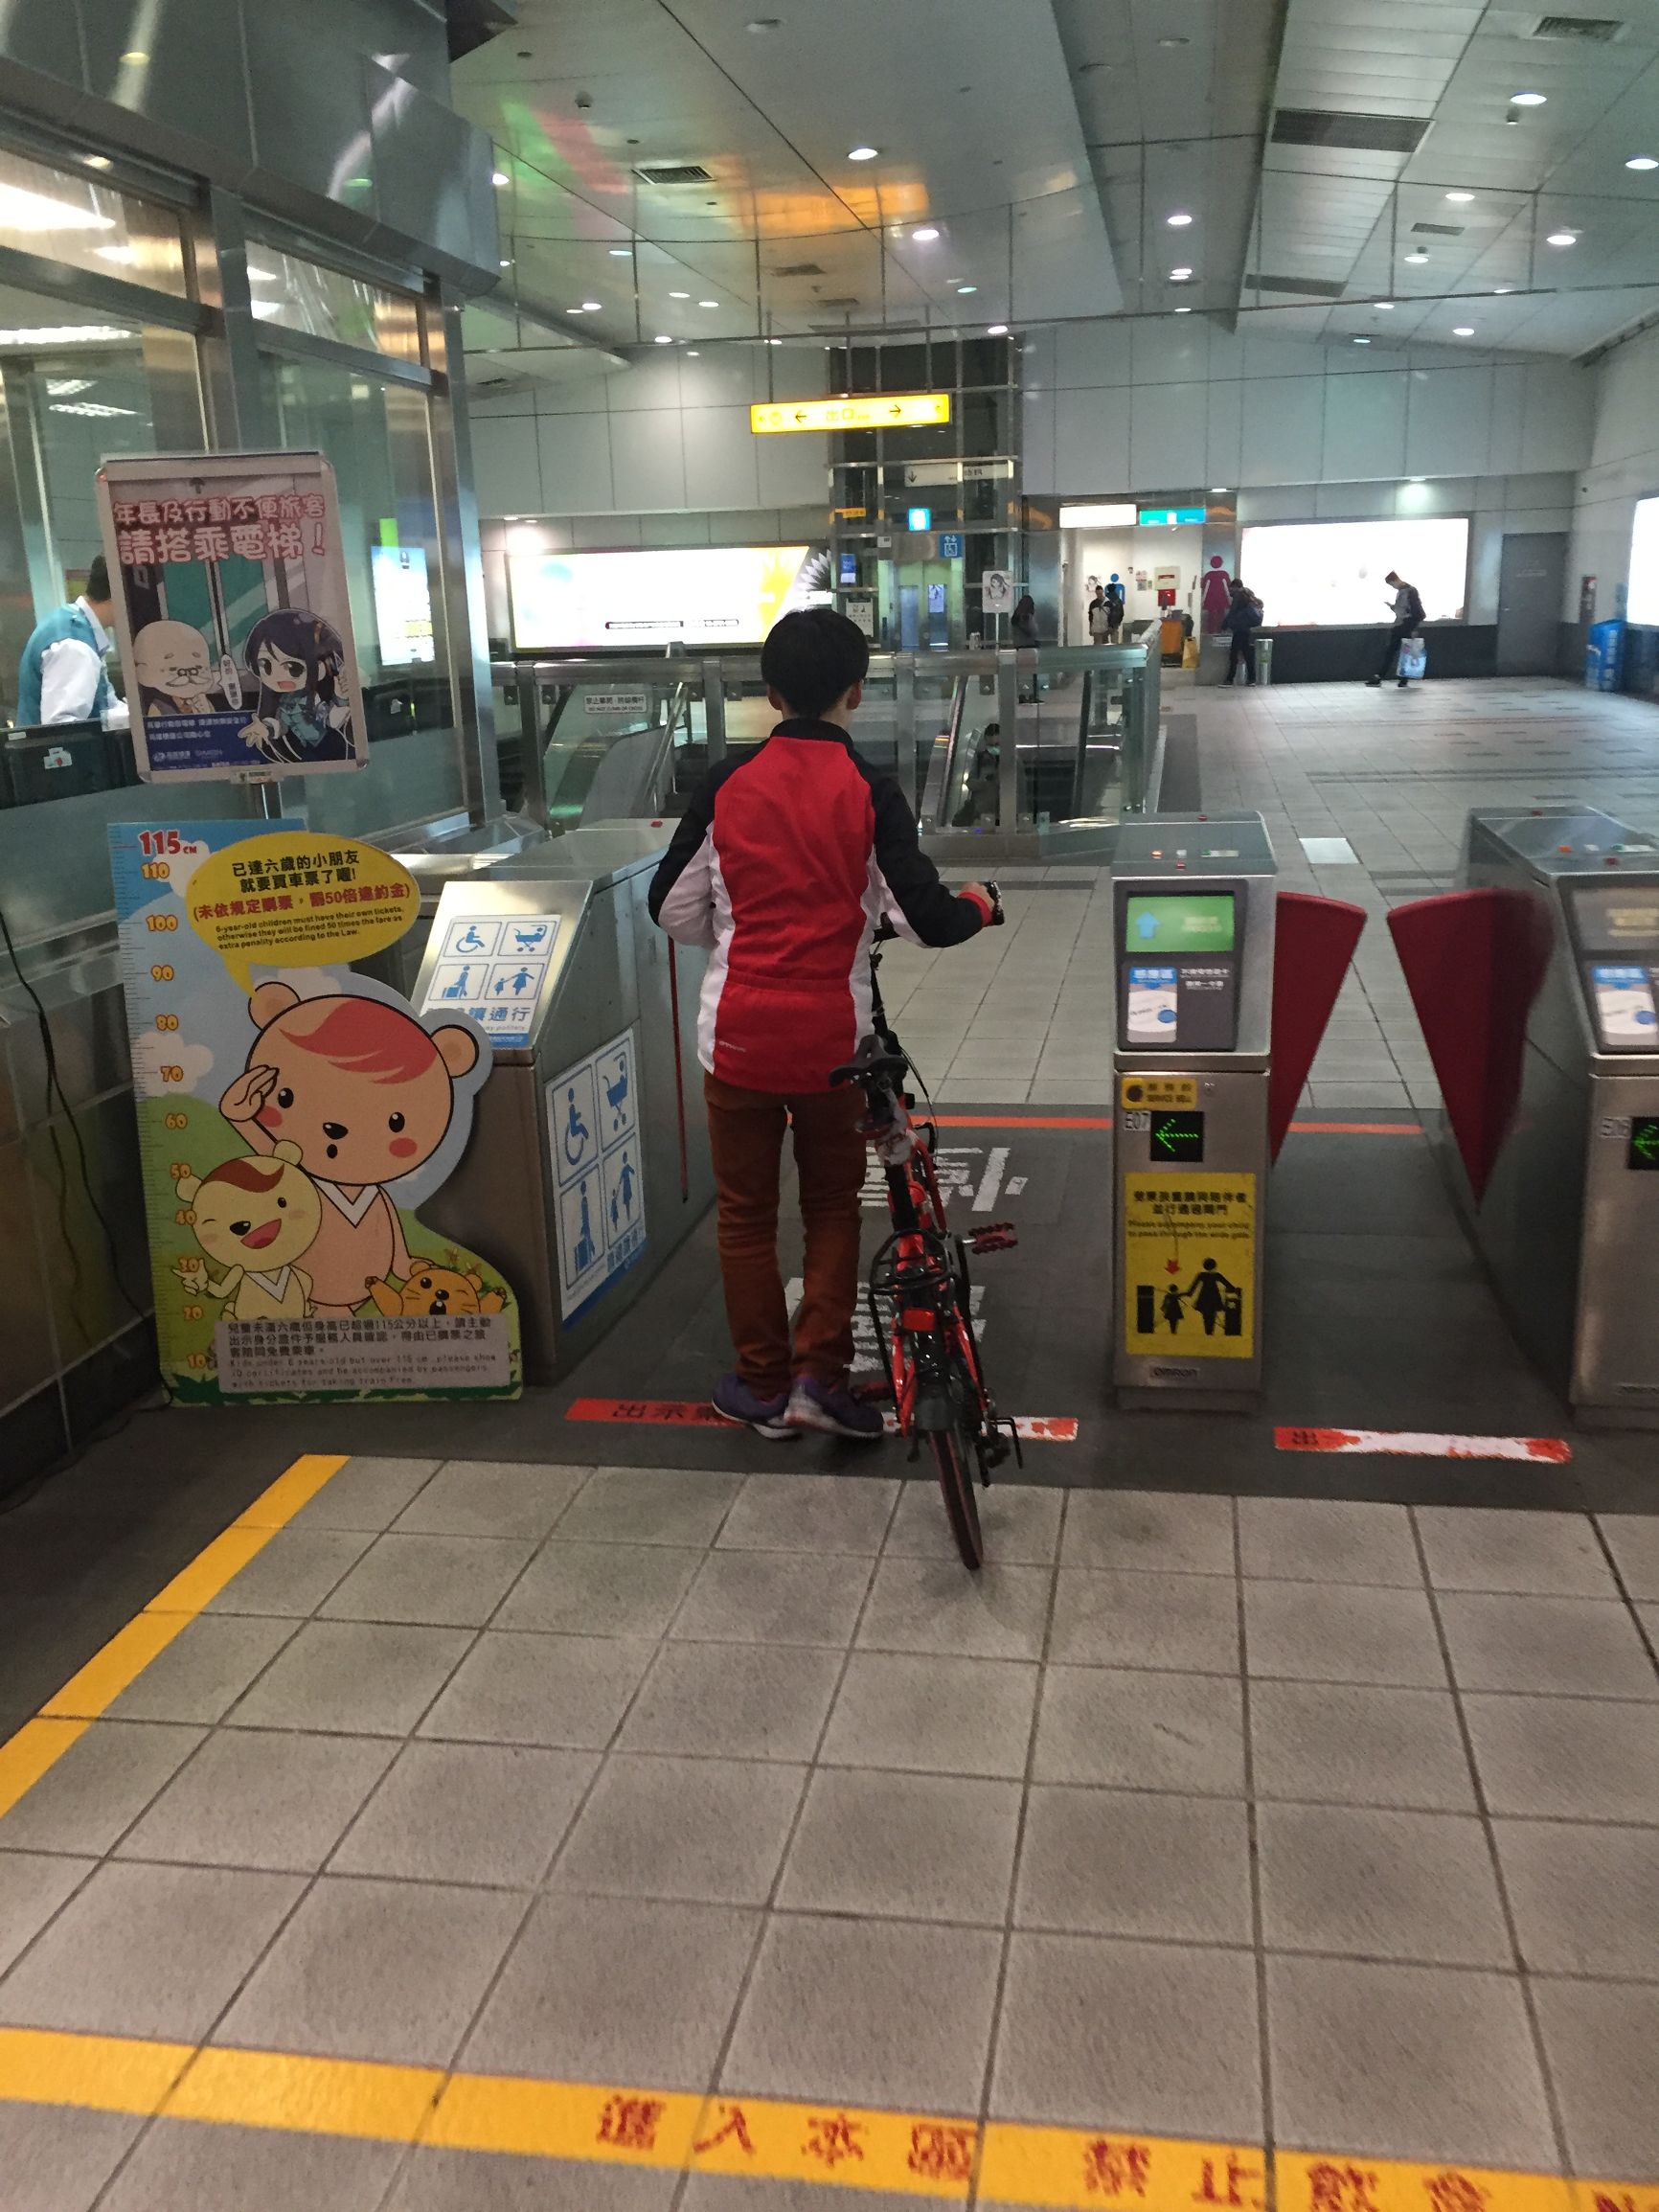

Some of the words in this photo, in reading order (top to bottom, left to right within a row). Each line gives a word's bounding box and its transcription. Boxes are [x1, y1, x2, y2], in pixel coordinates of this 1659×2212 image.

[113, 493, 325, 526] 年長及行動不便旅客
[142, 862, 170, 879] 110
[232, 850, 360, 878] 已達六歲的小朋友
[146, 915, 178, 932] 100
[216, 922, 257, 933] 6-year-old
[259, 919, 291, 928] children
[293, 916, 314, 924] must
[315, 913, 334, 922] have
[336, 911, 354, 920] their
[217, 931, 257, 941] otherwise
[259, 929, 276, 938] they
[278, 926, 292, 935] will
[305, 923, 326, 931] fined
[338, 920, 360, 928] times
[218, 942, 239, 950] extra
[274, 933, 316, 944] according
[150, 965, 174, 981] 90
[156, 1015, 179, 1031] 80
[161, 1065, 184, 1082] 70
[165, 1113, 188, 1129] 60
[1125, 1111, 1149, 1129] E07
[170, 1162, 192, 1179] 50
[175, 1209, 197, 1226] 40
[179, 1257, 199, 1274] 30
[183, 1305, 204, 1321] 20
[188, 1354, 207, 1370] 10
[597, 2095, 979, 2181] 進入本區
